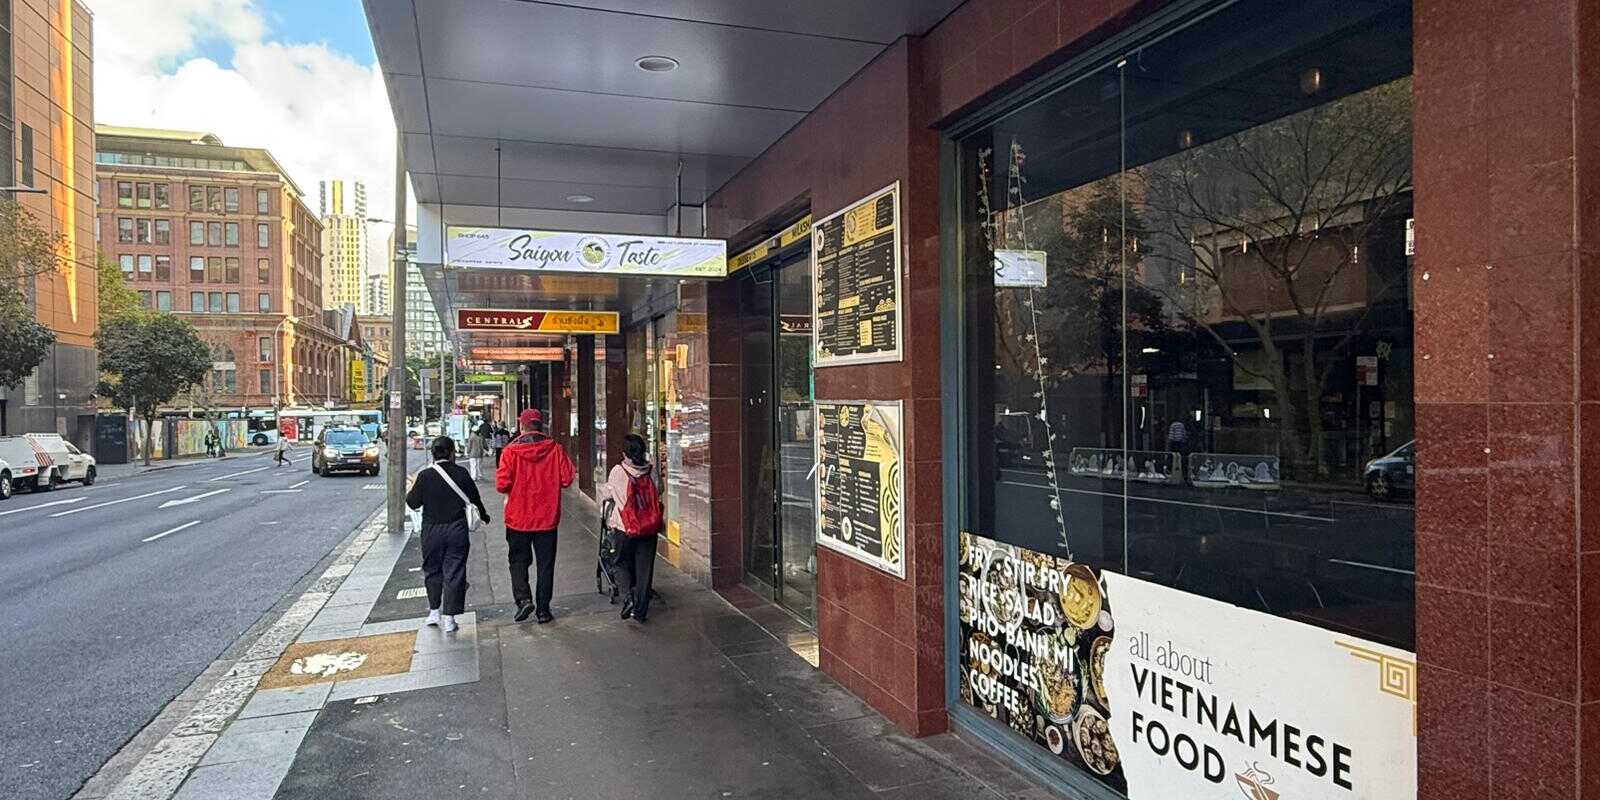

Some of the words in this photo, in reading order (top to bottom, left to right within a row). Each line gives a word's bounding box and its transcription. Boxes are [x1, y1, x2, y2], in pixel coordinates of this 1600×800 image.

[508, 234, 574, 268] Saigon
[617, 240, 661, 267] Taste
[466, 315, 522, 325] CENTRAL
[969, 545, 993, 571] FRY
[1003, 556, 1037, 588] STIR
[1040, 566, 1072, 597] FRY
[969, 637, 1041, 693] NOODLES
[1054, 643, 1075, 674] MI
[1129, 631, 1149, 661] all
[1156, 640, 1213, 684] about
[970, 668, 1021, 714] COFFEE
[1130, 662, 1353, 791] VIETNAMESE
[1132, 711, 1226, 784] FOOD
